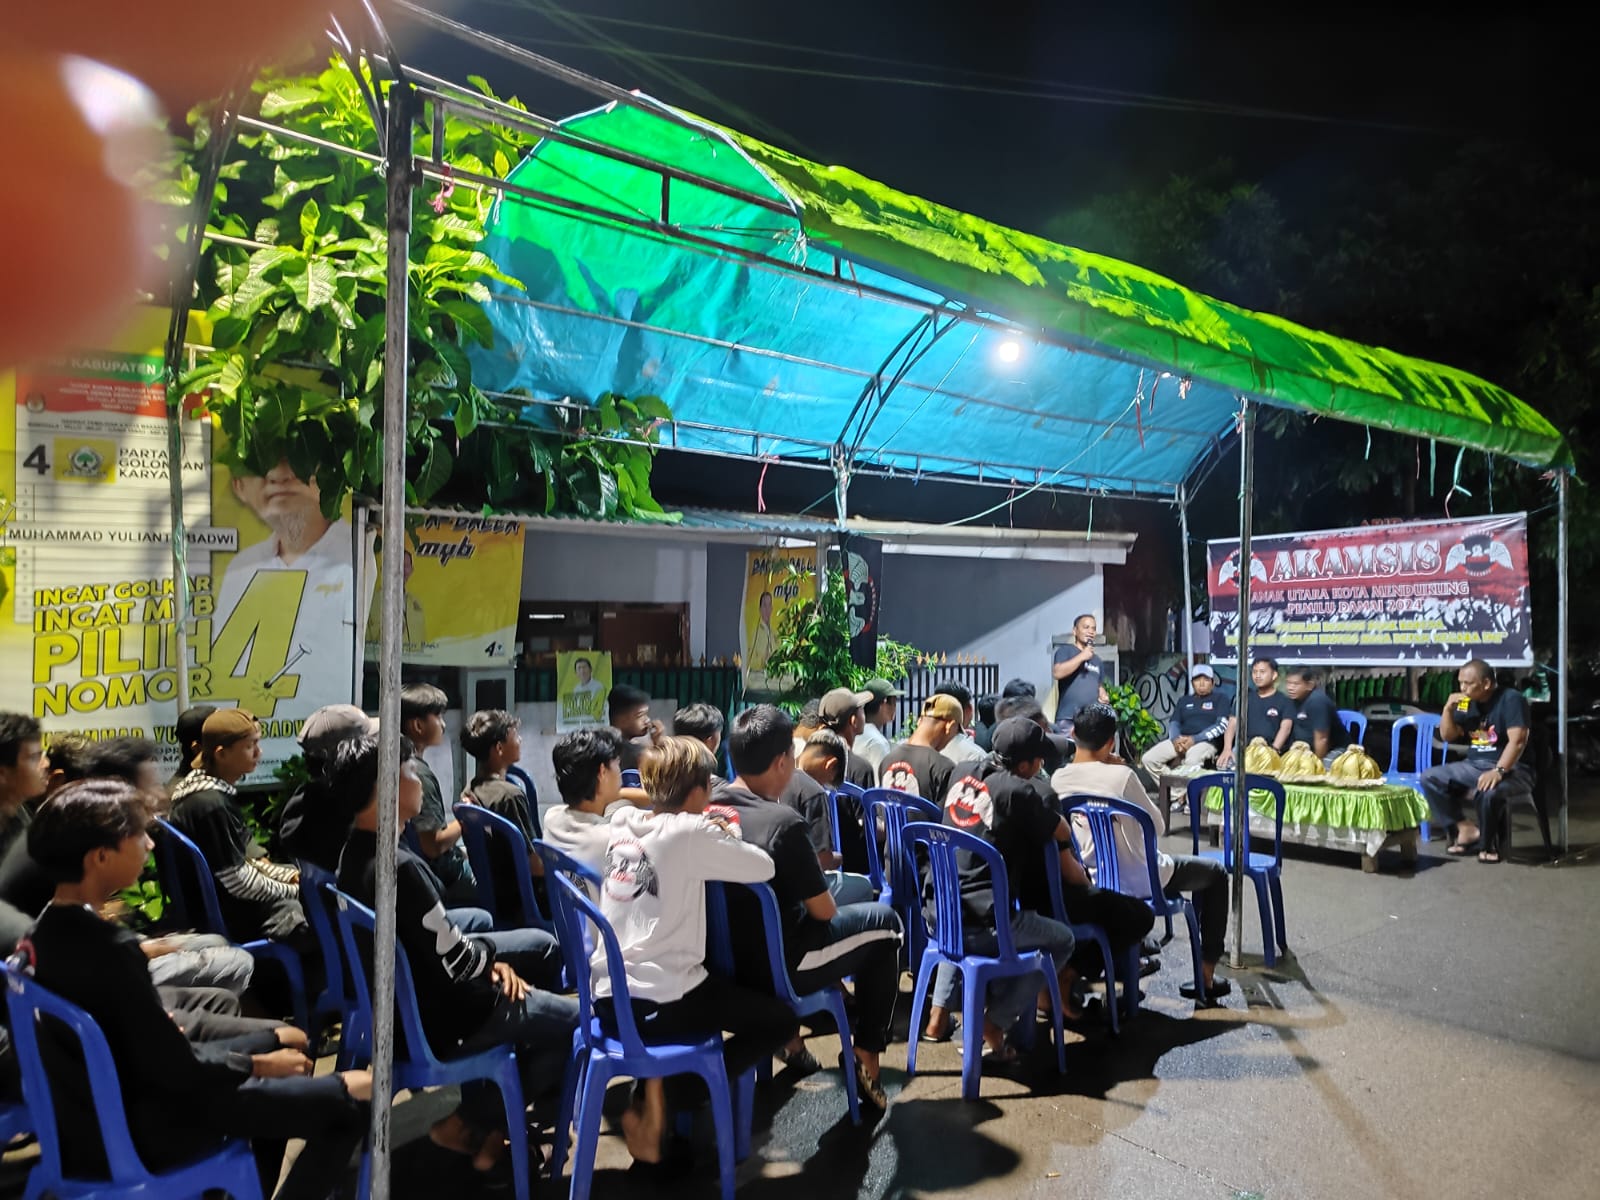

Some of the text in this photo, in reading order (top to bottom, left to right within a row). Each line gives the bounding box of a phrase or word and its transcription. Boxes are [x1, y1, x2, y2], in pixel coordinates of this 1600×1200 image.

[23, 444, 50, 475] 4
[118, 459, 204, 471] GOLONAN
[119, 448, 169, 460] PARTA
[119, 469, 169, 479] KARYA
[9, 529, 234, 545] MUHAMMAD YULIANT BADWI
[416, 535, 475, 567] myb
[1270, 539, 1442, 583] AKAMSIS
[33, 583, 110, 608] INGAT
[1332, 585, 1369, 599] KOTA
[1371, 581, 1470, 598] MENDUKUNG
[33, 593, 215, 634] INGAT MB
[1386, 599, 1424, 613] 2024
[32, 618, 214, 685] PILIH
[188, 569, 308, 718] 4
[32, 666, 213, 719] NOMOR
